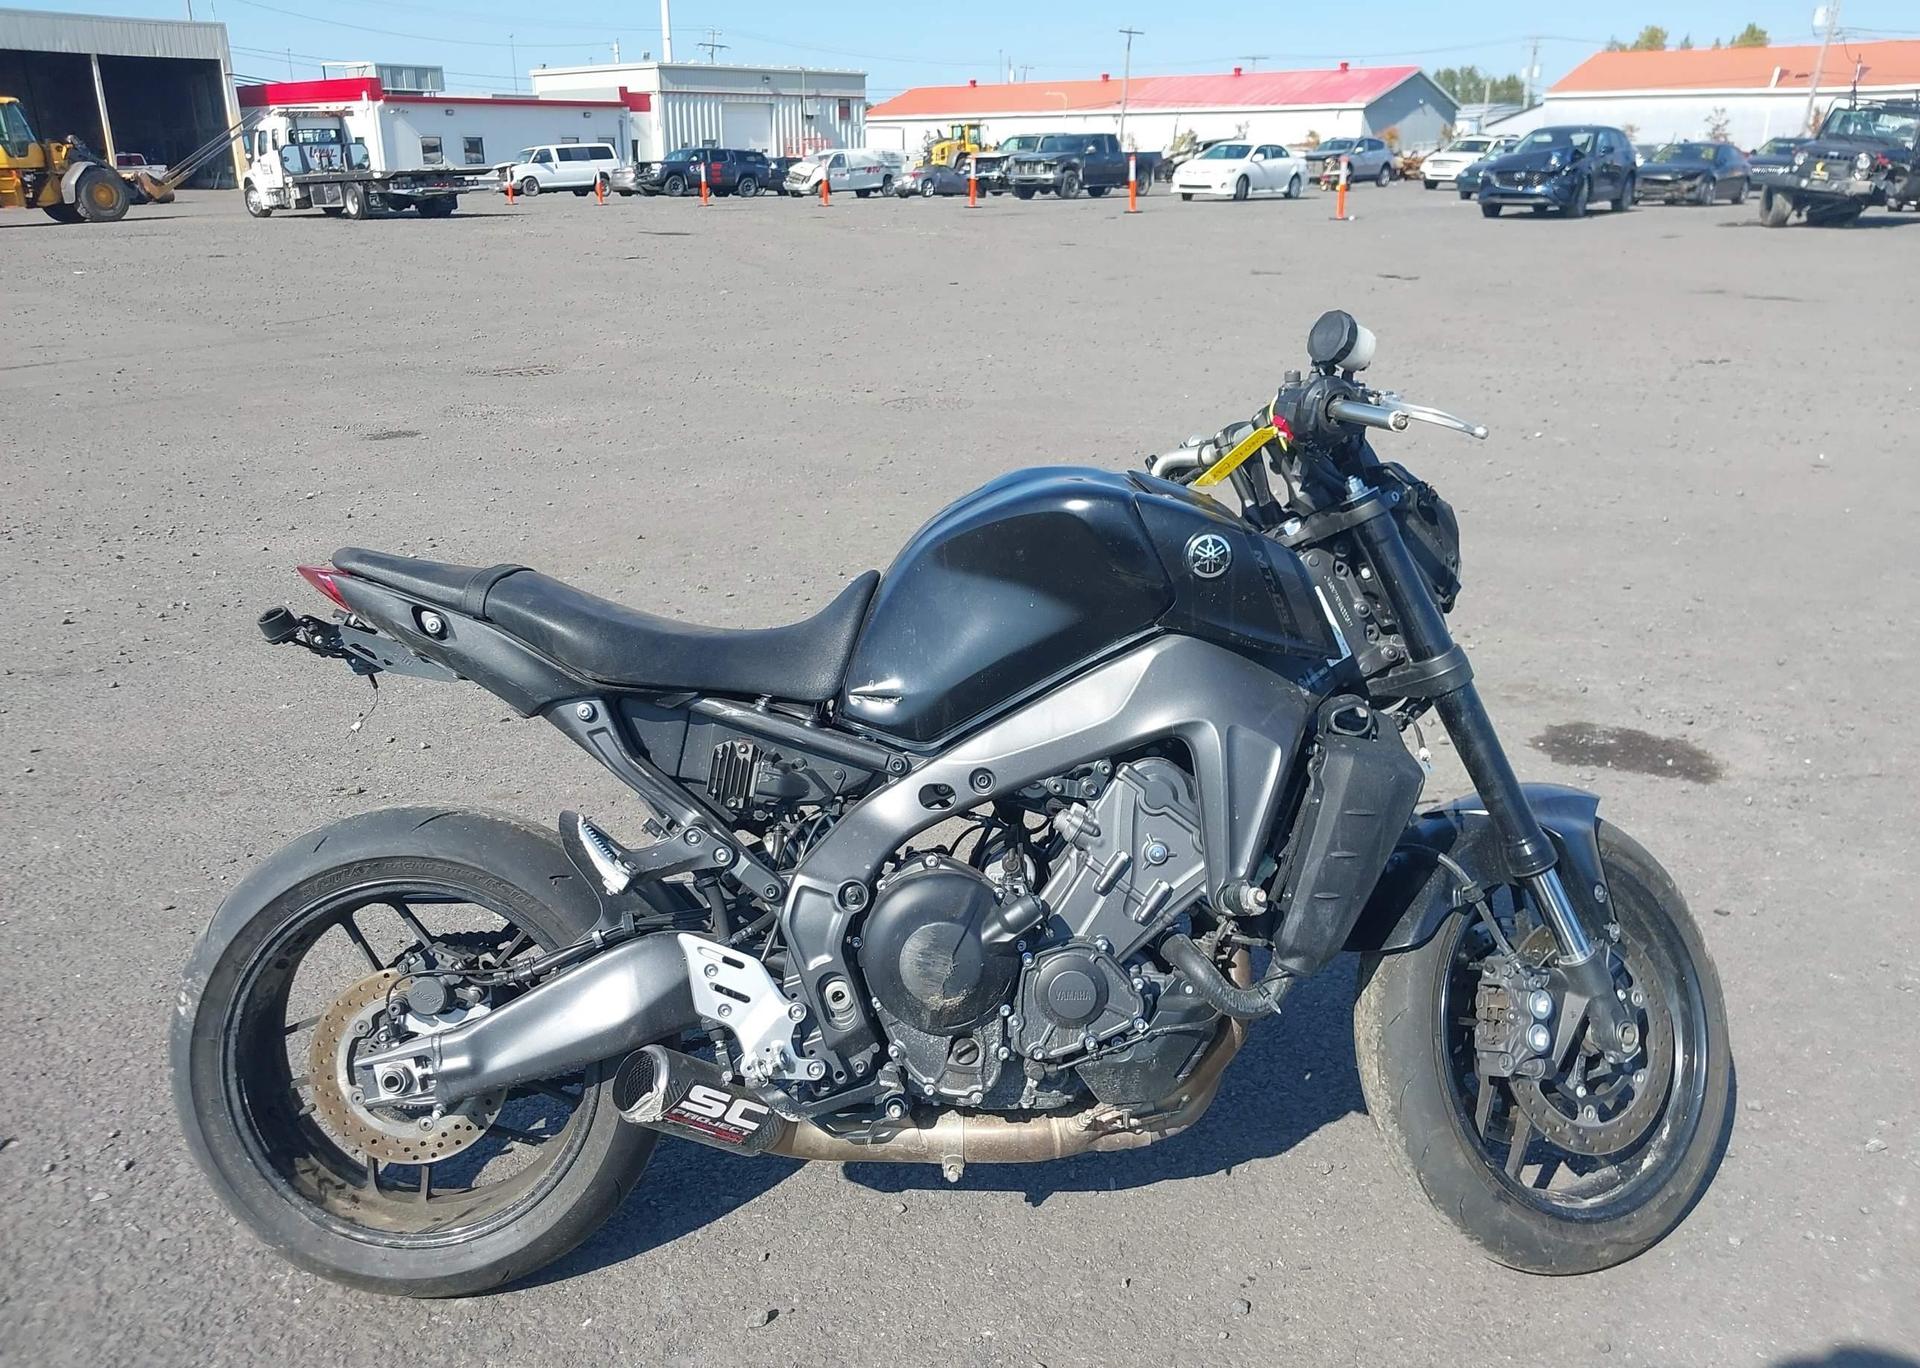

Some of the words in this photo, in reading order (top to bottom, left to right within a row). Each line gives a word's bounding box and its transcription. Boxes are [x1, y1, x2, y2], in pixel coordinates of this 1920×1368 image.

[1056, 990, 1091, 1001] YAMAHA
[677, 1084, 770, 1131] SC
[671, 1108, 752, 1136] PROJECT
